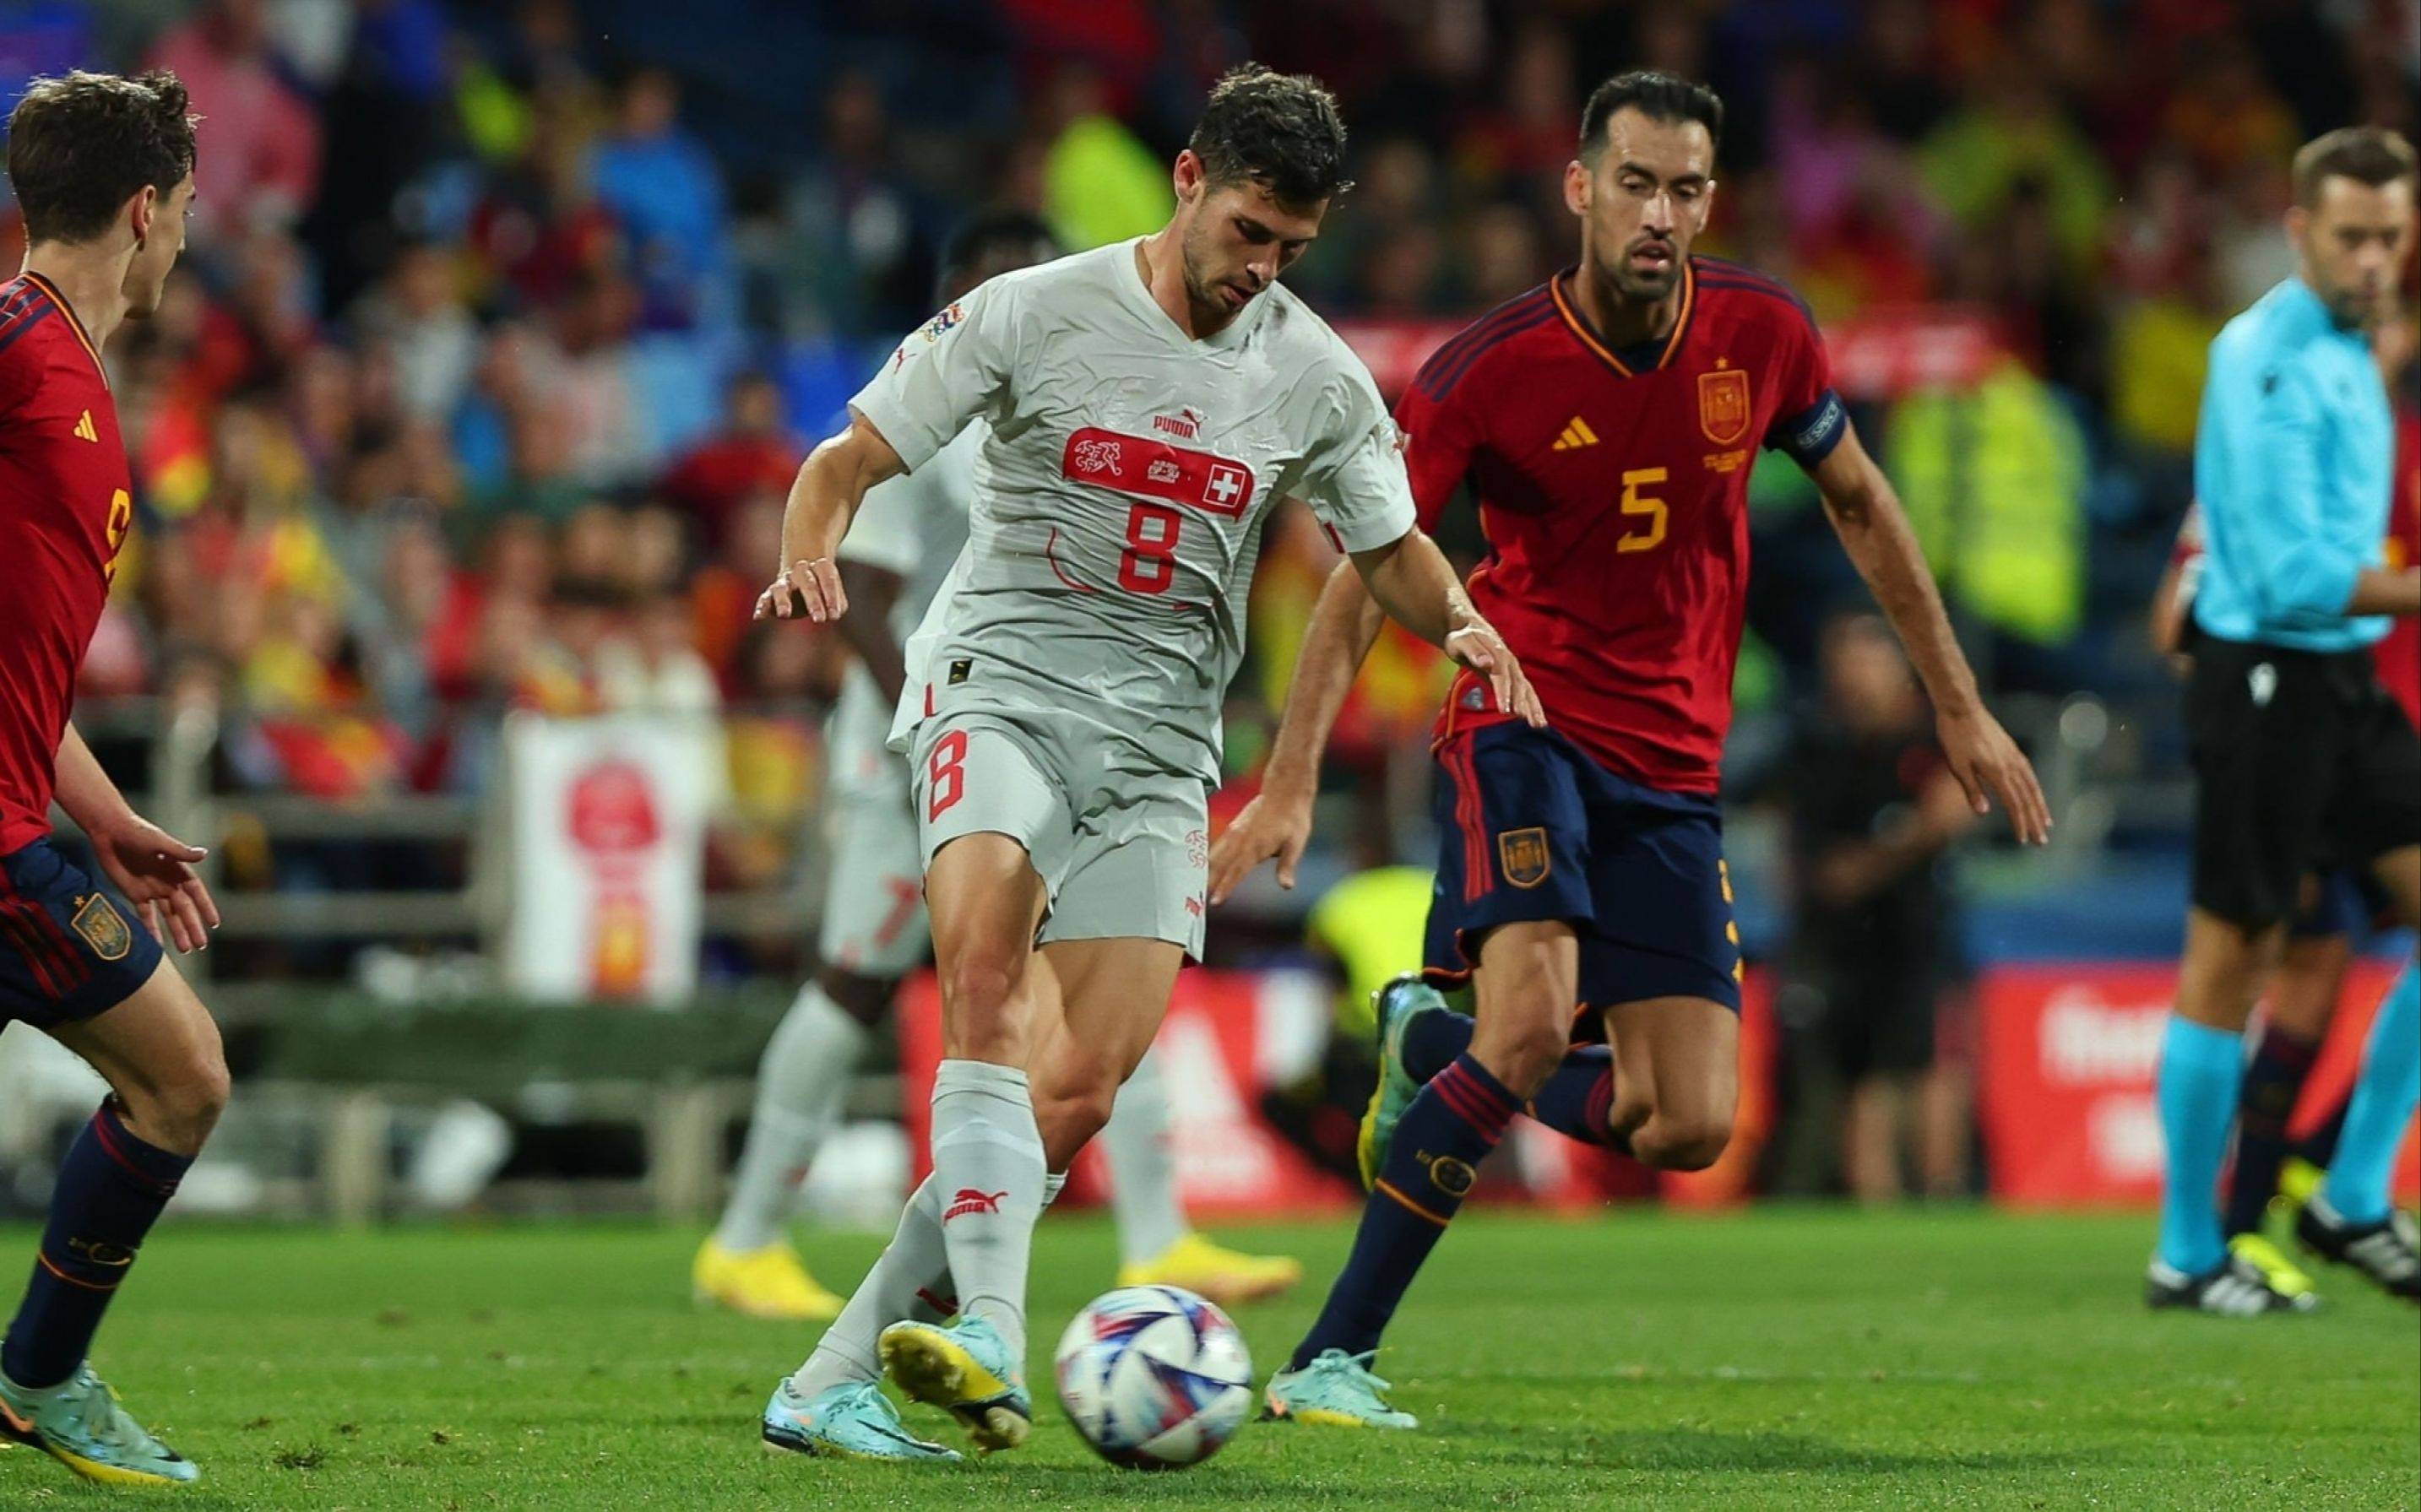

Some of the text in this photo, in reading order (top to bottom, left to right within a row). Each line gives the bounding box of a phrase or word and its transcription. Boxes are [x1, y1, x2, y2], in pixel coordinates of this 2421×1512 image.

[1154, 415, 1194, 439] PUMA
[1118, 504, 1182, 595] 8
[1617, 466, 1668, 553] 5
[930, 729, 968, 824] 8
